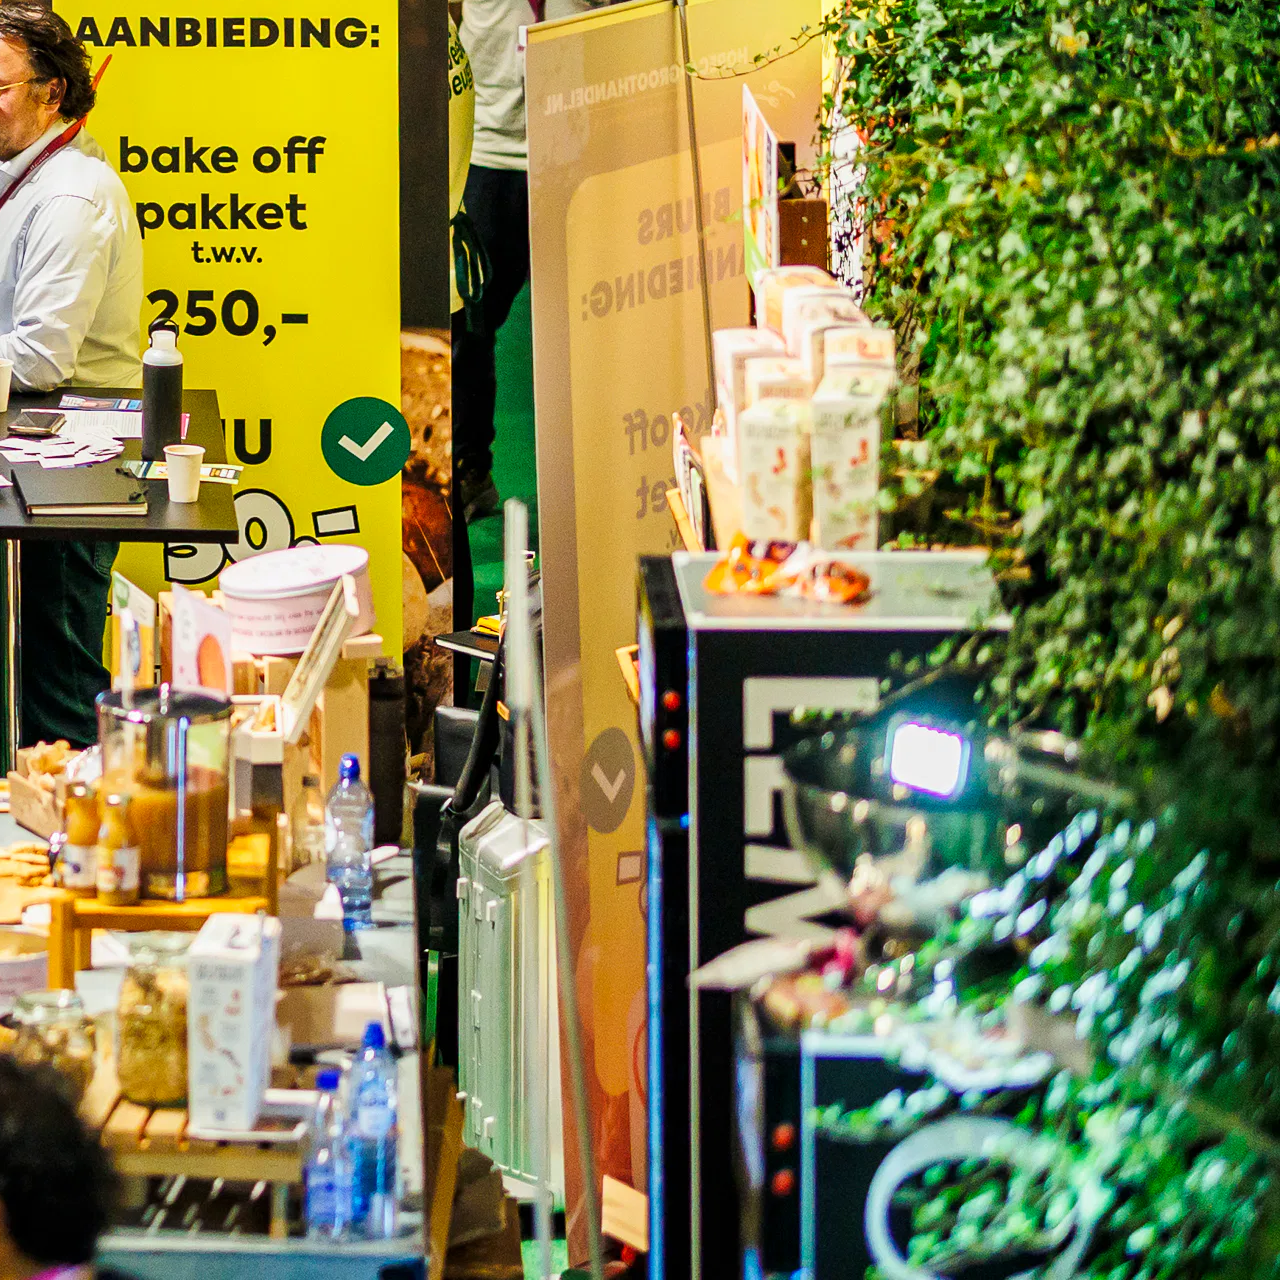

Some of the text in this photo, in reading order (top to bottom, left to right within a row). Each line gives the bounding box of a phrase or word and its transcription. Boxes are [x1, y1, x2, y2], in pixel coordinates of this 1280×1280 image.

[75, 17, 381, 49] AANBIEDING:
[119, 136, 326, 175] bake off
[136, 193, 308, 238] pakket
[191, 241, 263, 264] t.w.v.
[146, 289, 309, 345] 250,-
[221, 419, 272, 465] U
